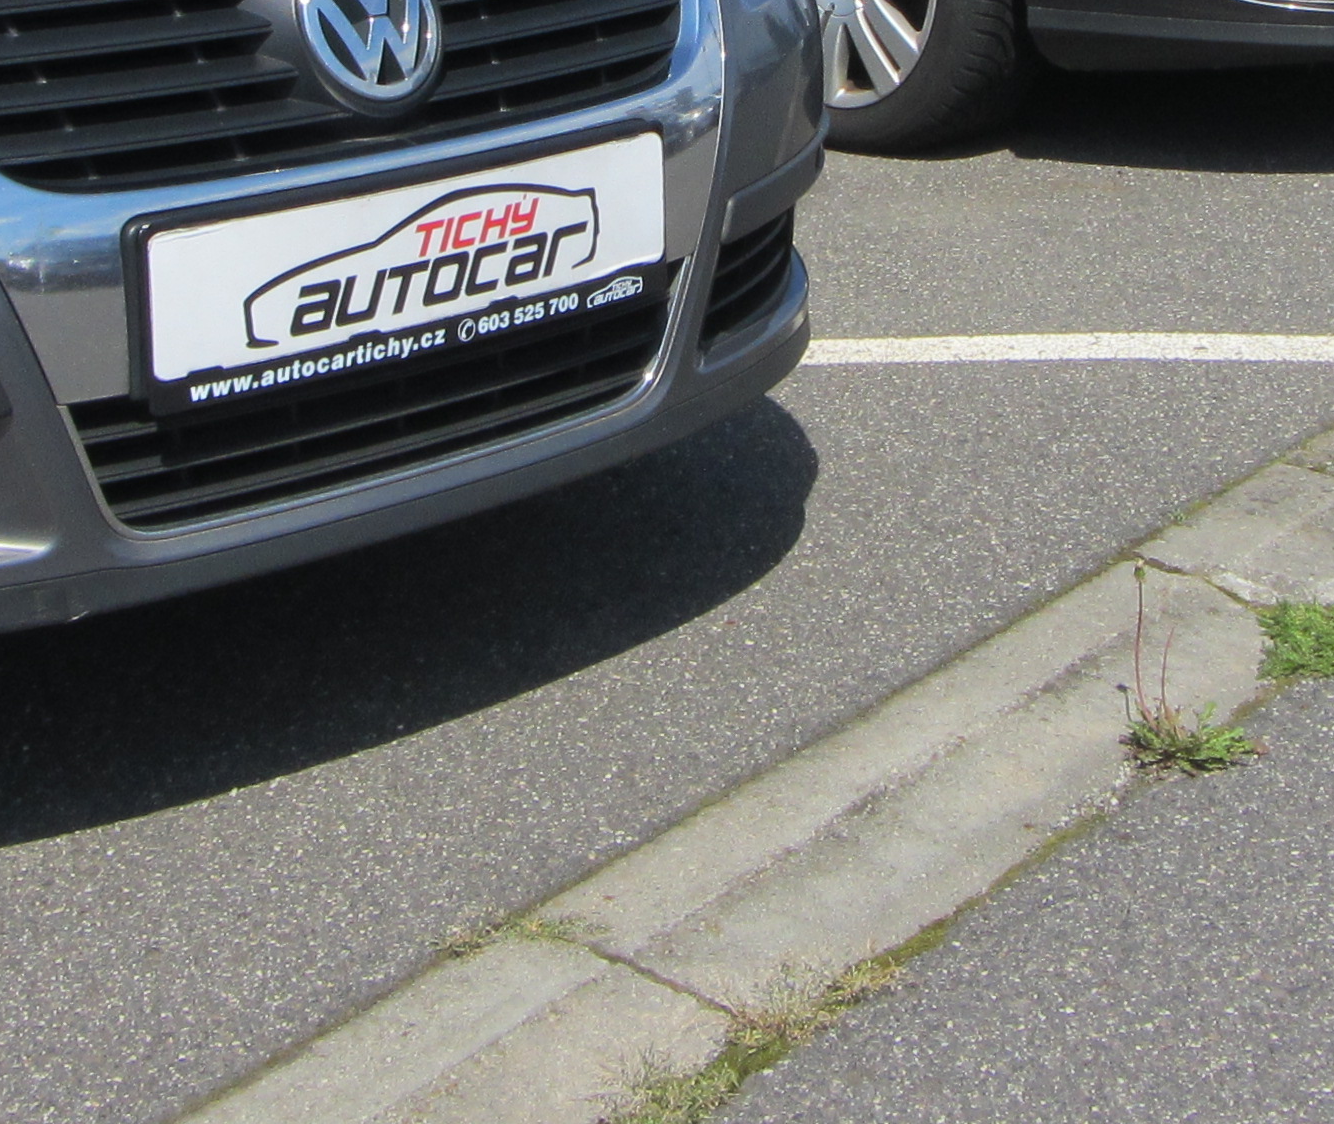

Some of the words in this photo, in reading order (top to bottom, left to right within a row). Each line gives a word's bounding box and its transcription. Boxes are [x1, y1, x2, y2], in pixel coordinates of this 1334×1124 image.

[189, 325, 447, 403] www.autocartichy.cz
[478, 311, 510, 336] 603
[512, 303, 546, 328] 525
[548, 293, 579, 319] 700
